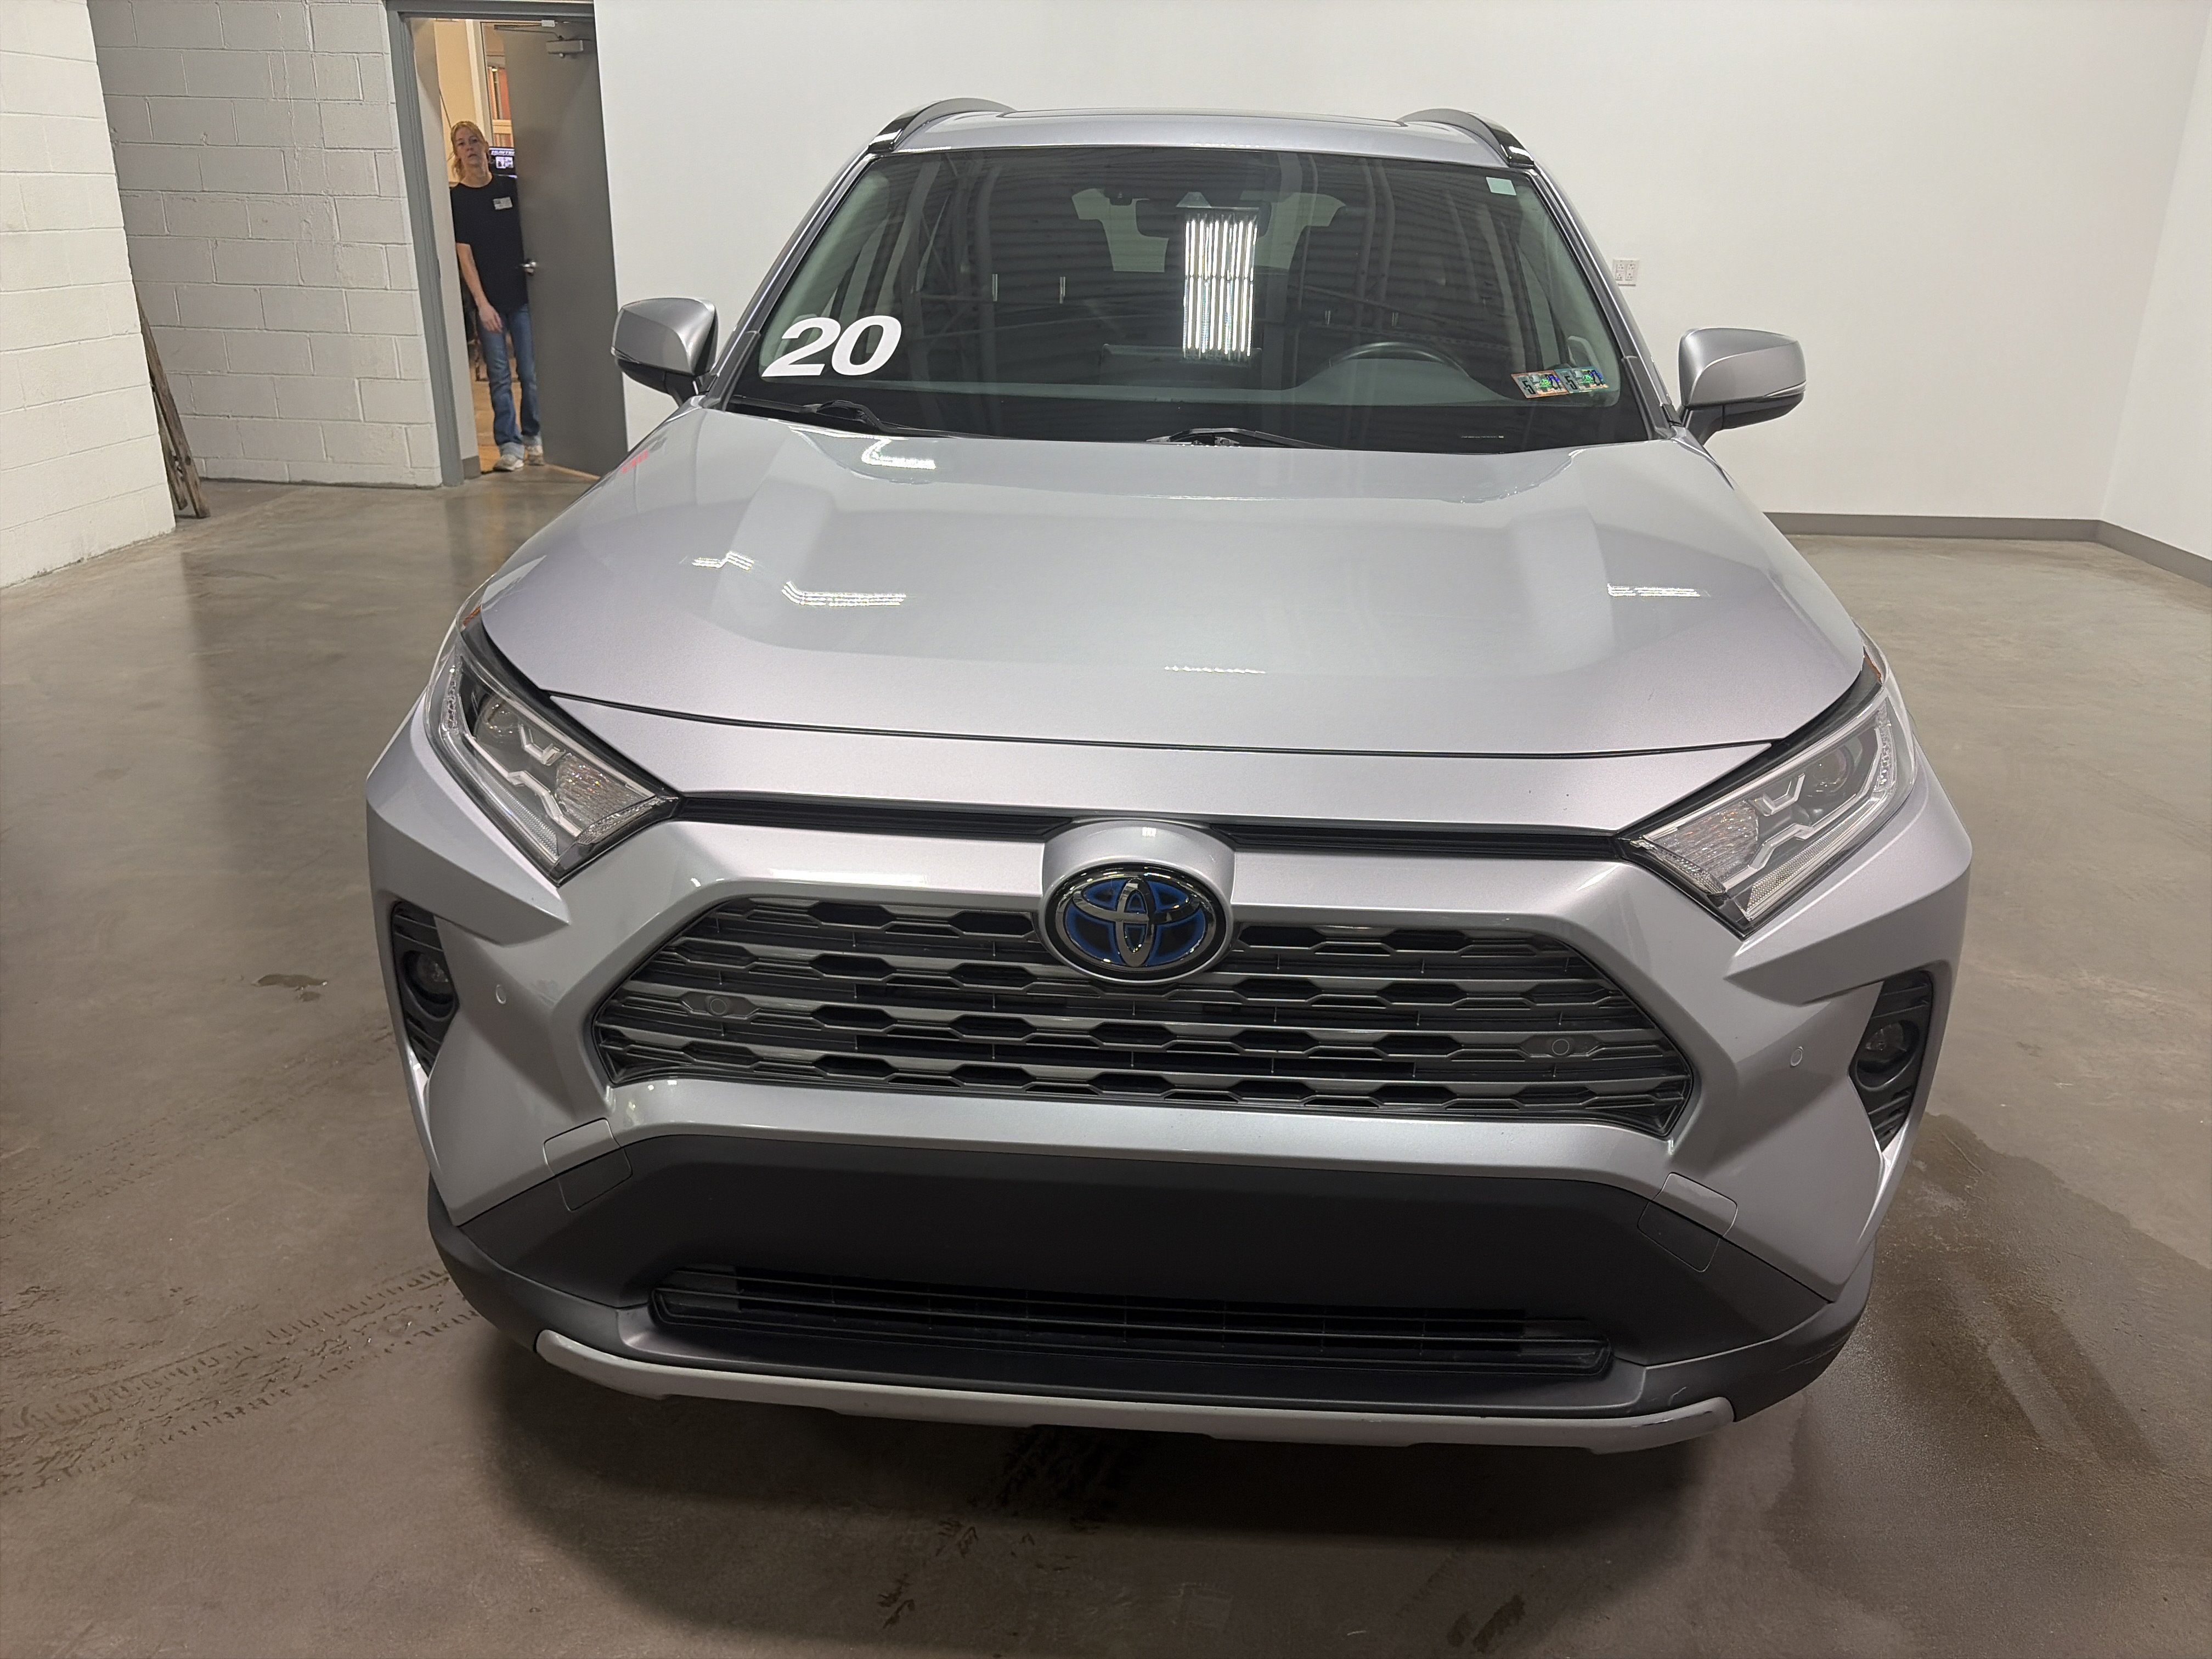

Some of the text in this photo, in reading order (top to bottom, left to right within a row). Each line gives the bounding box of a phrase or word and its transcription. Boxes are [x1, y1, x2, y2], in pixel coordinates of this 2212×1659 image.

[761, 315, 902, 377] 20
[1522, 380, 1536, 394] 5
[1564, 376, 1578, 390] 5
